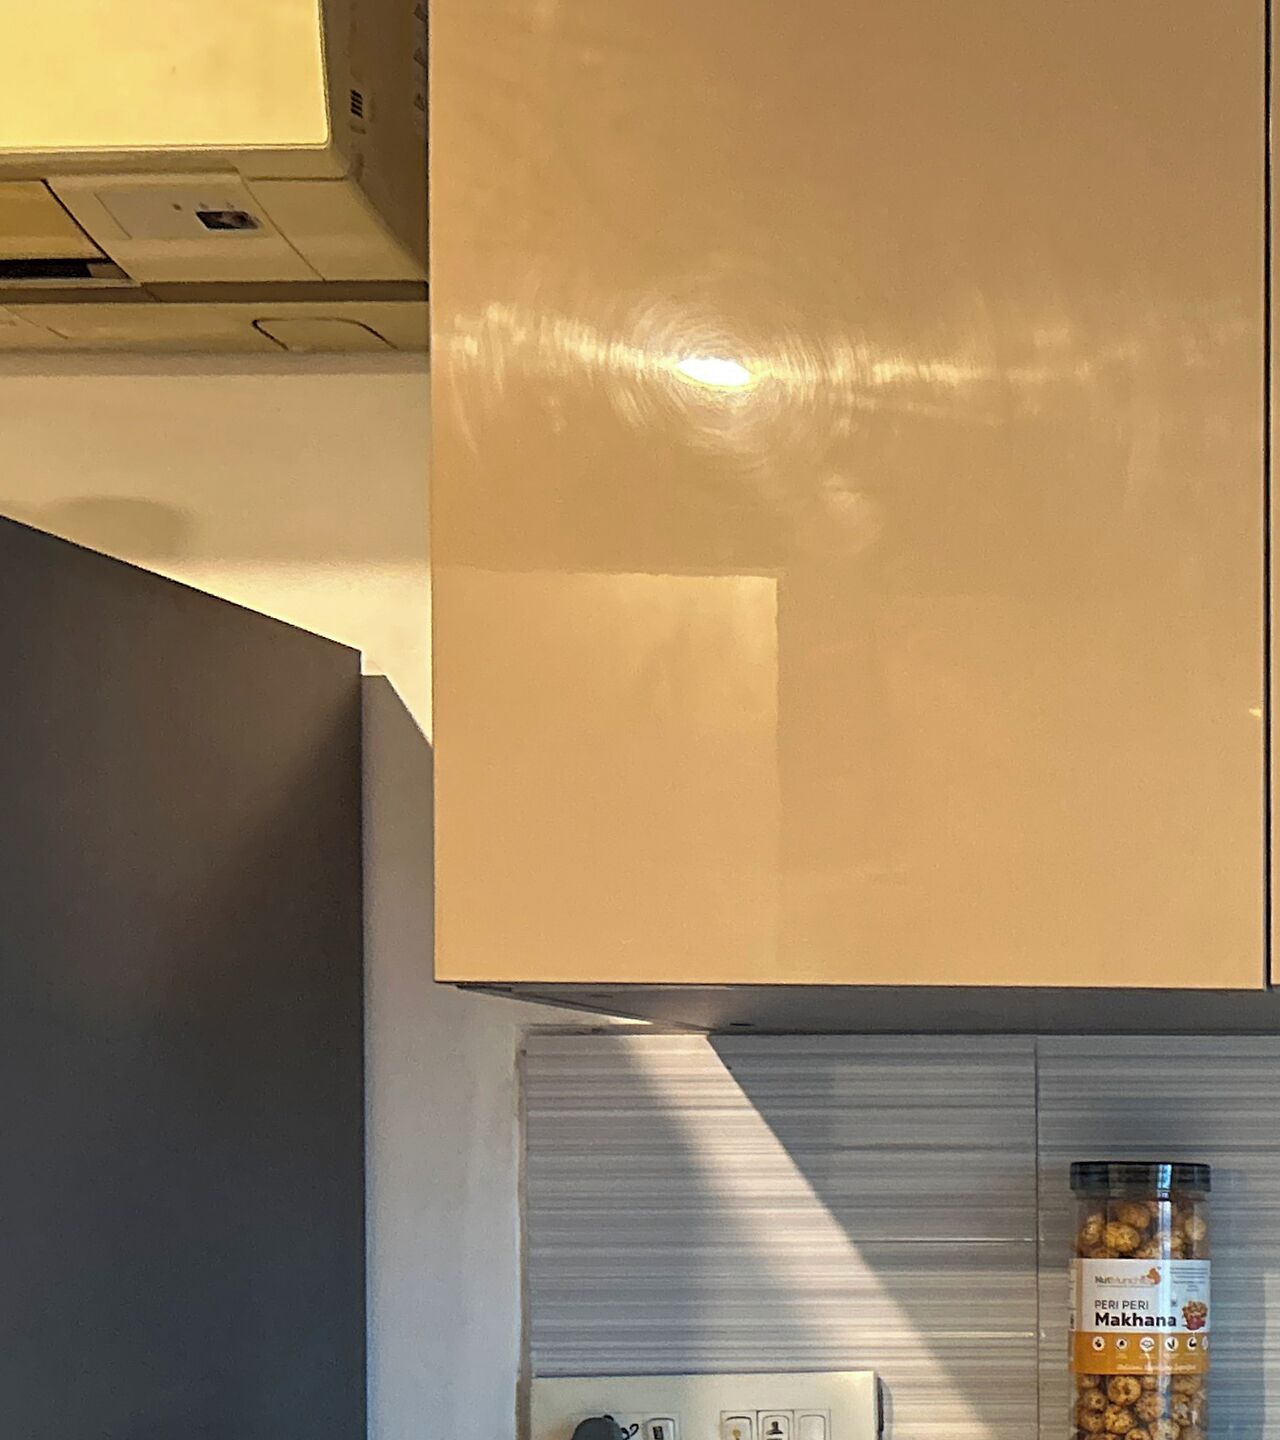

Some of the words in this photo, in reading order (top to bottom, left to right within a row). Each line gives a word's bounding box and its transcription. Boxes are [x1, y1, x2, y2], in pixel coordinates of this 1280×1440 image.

[1095, 1300, 1119, 1310] PERI
[1122, 1300, 1149, 1310] PERI
[1095, 1312, 1177, 1327] Makhana
